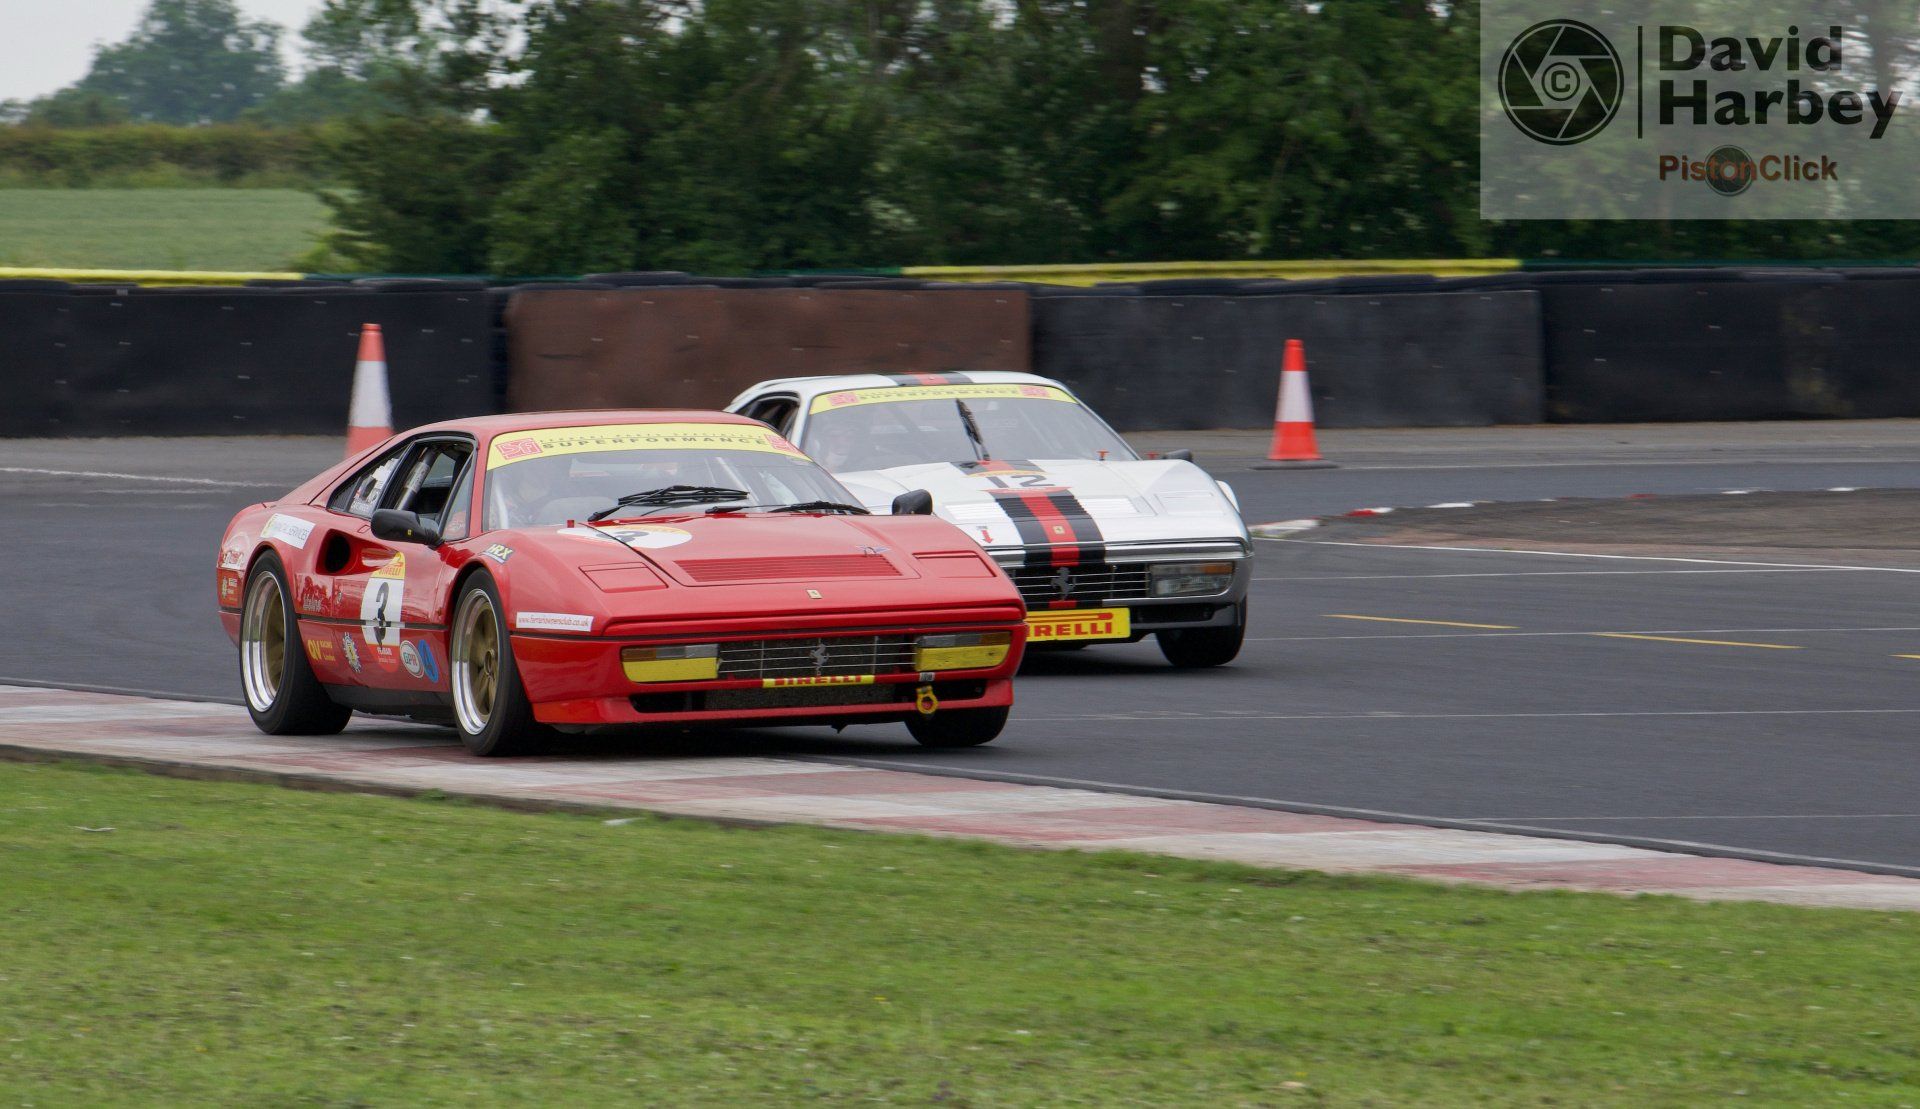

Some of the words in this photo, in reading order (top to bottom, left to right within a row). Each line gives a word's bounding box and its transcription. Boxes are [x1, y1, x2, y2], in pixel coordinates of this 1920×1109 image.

[542, 437, 768, 449] SUPERFORMANCE
[986, 474, 1056, 488] 12
[374, 581, 390, 646] 3
